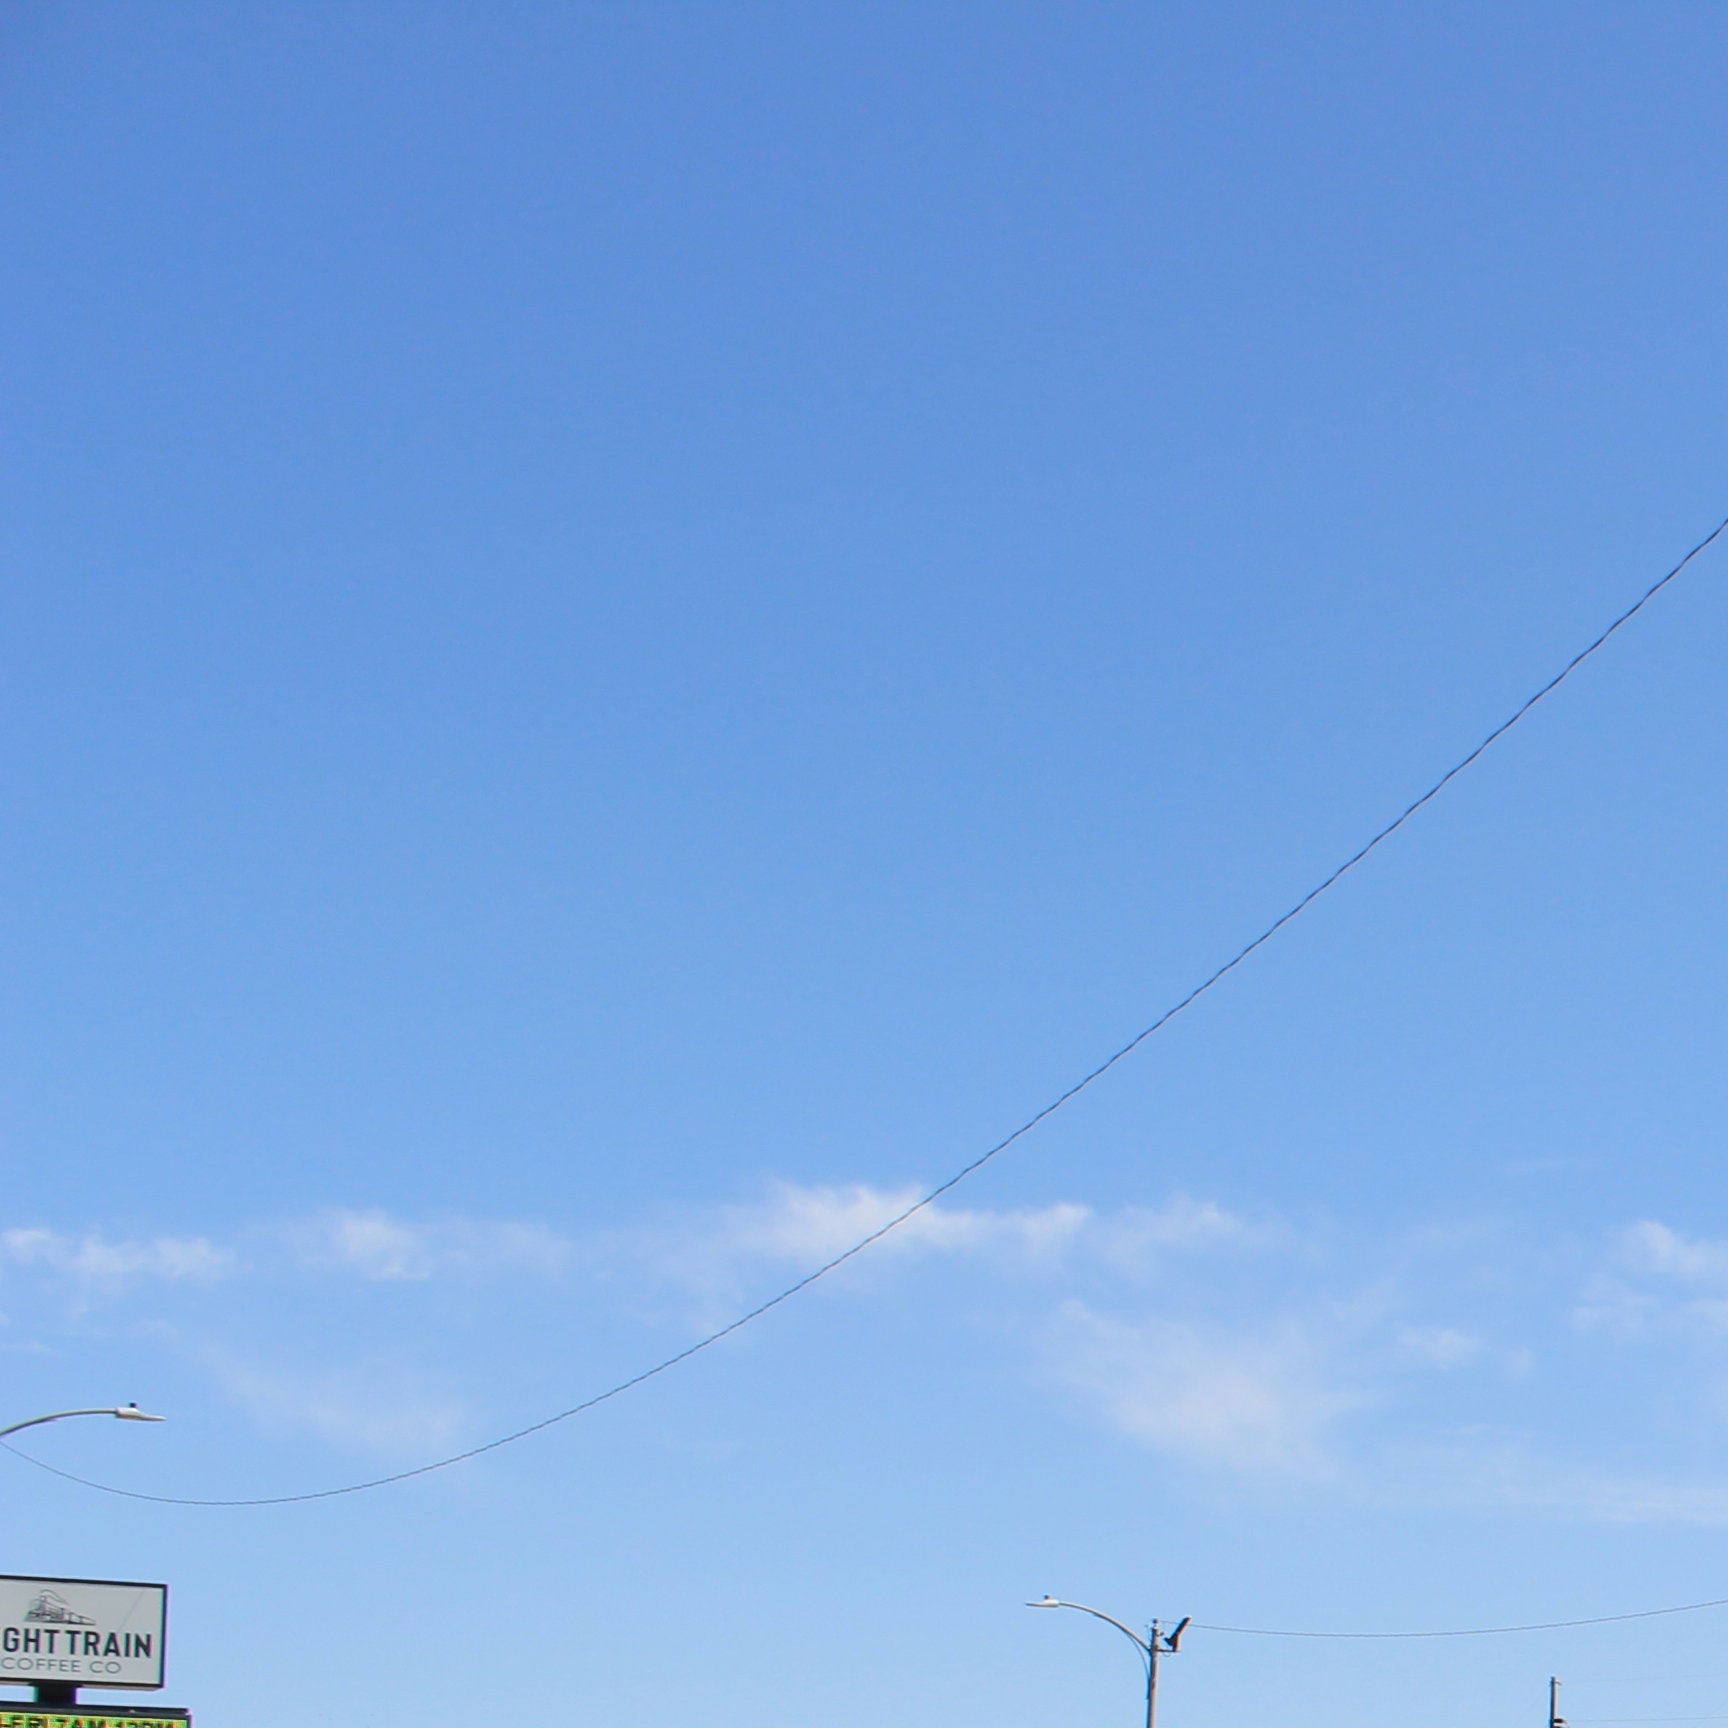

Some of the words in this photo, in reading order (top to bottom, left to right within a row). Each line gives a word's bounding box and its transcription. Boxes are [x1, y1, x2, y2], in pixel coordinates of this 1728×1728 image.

[2, 1626, 60, 1654] GHT
[65, 1629, 152, 1658] TRAIN
[1, 1656, 82, 1673] COFFEE
[90, 1660, 122, 1674] CO
